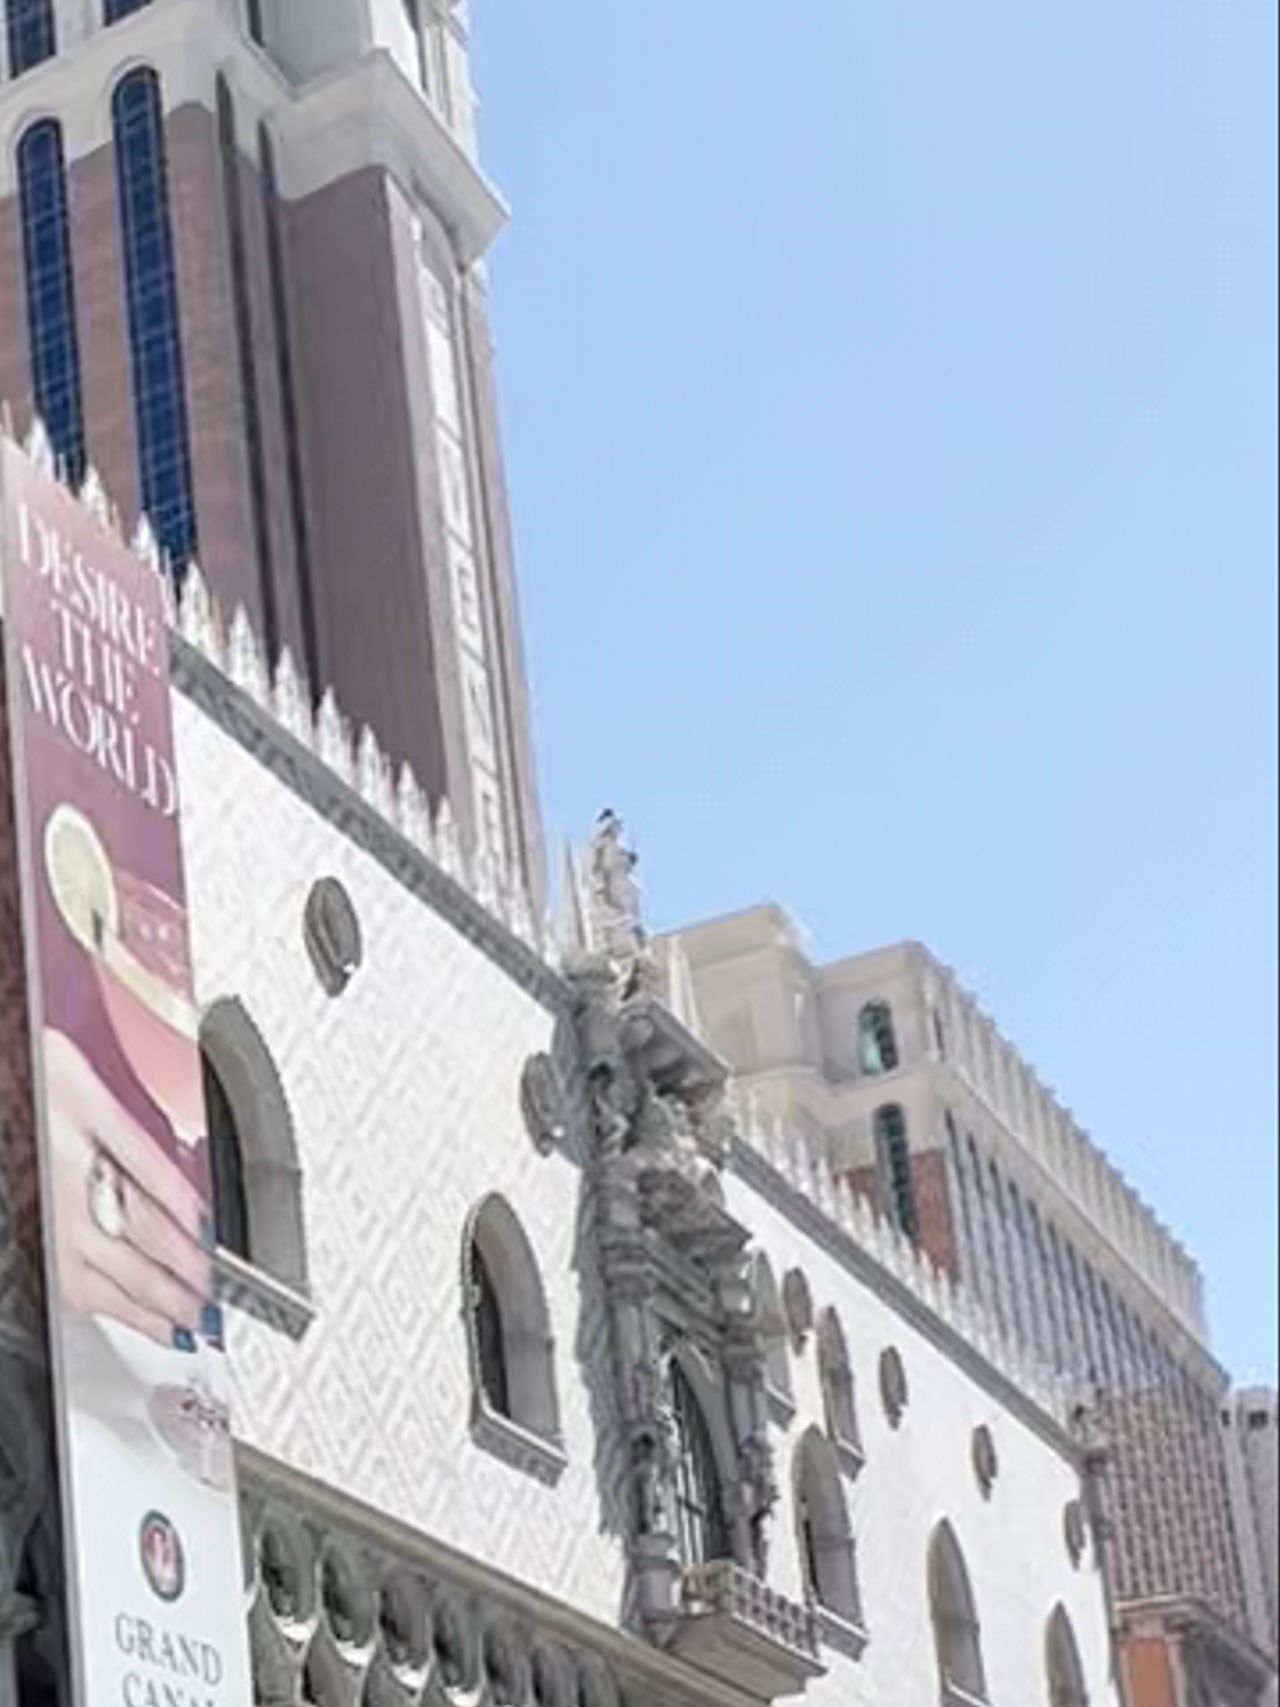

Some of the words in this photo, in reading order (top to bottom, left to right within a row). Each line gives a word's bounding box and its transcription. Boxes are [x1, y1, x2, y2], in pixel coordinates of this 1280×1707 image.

[18, 500, 161, 677] DESIRE
[51, 597, 140, 727] THE
[22, 642, 176, 817] WORLD
[114, 1611, 223, 1687] GRAND
